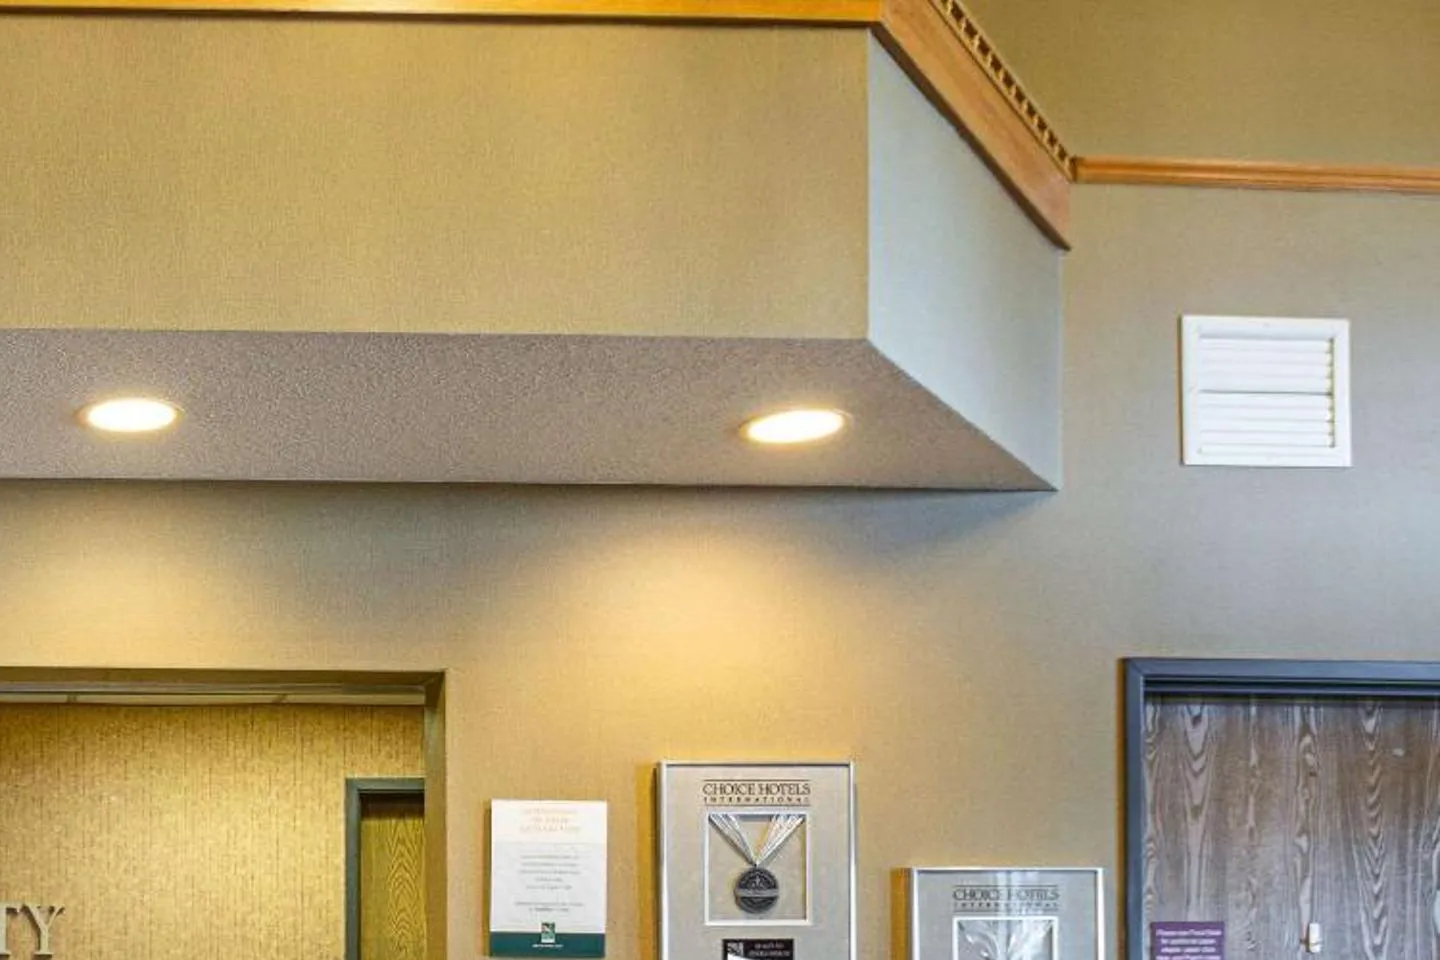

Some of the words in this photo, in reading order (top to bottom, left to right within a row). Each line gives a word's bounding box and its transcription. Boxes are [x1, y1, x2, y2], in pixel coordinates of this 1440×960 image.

[702, 782, 756, 796] CHOICE
[757, 782, 812, 796] HOTELS
[952, 888, 1006, 901] CHOIC
